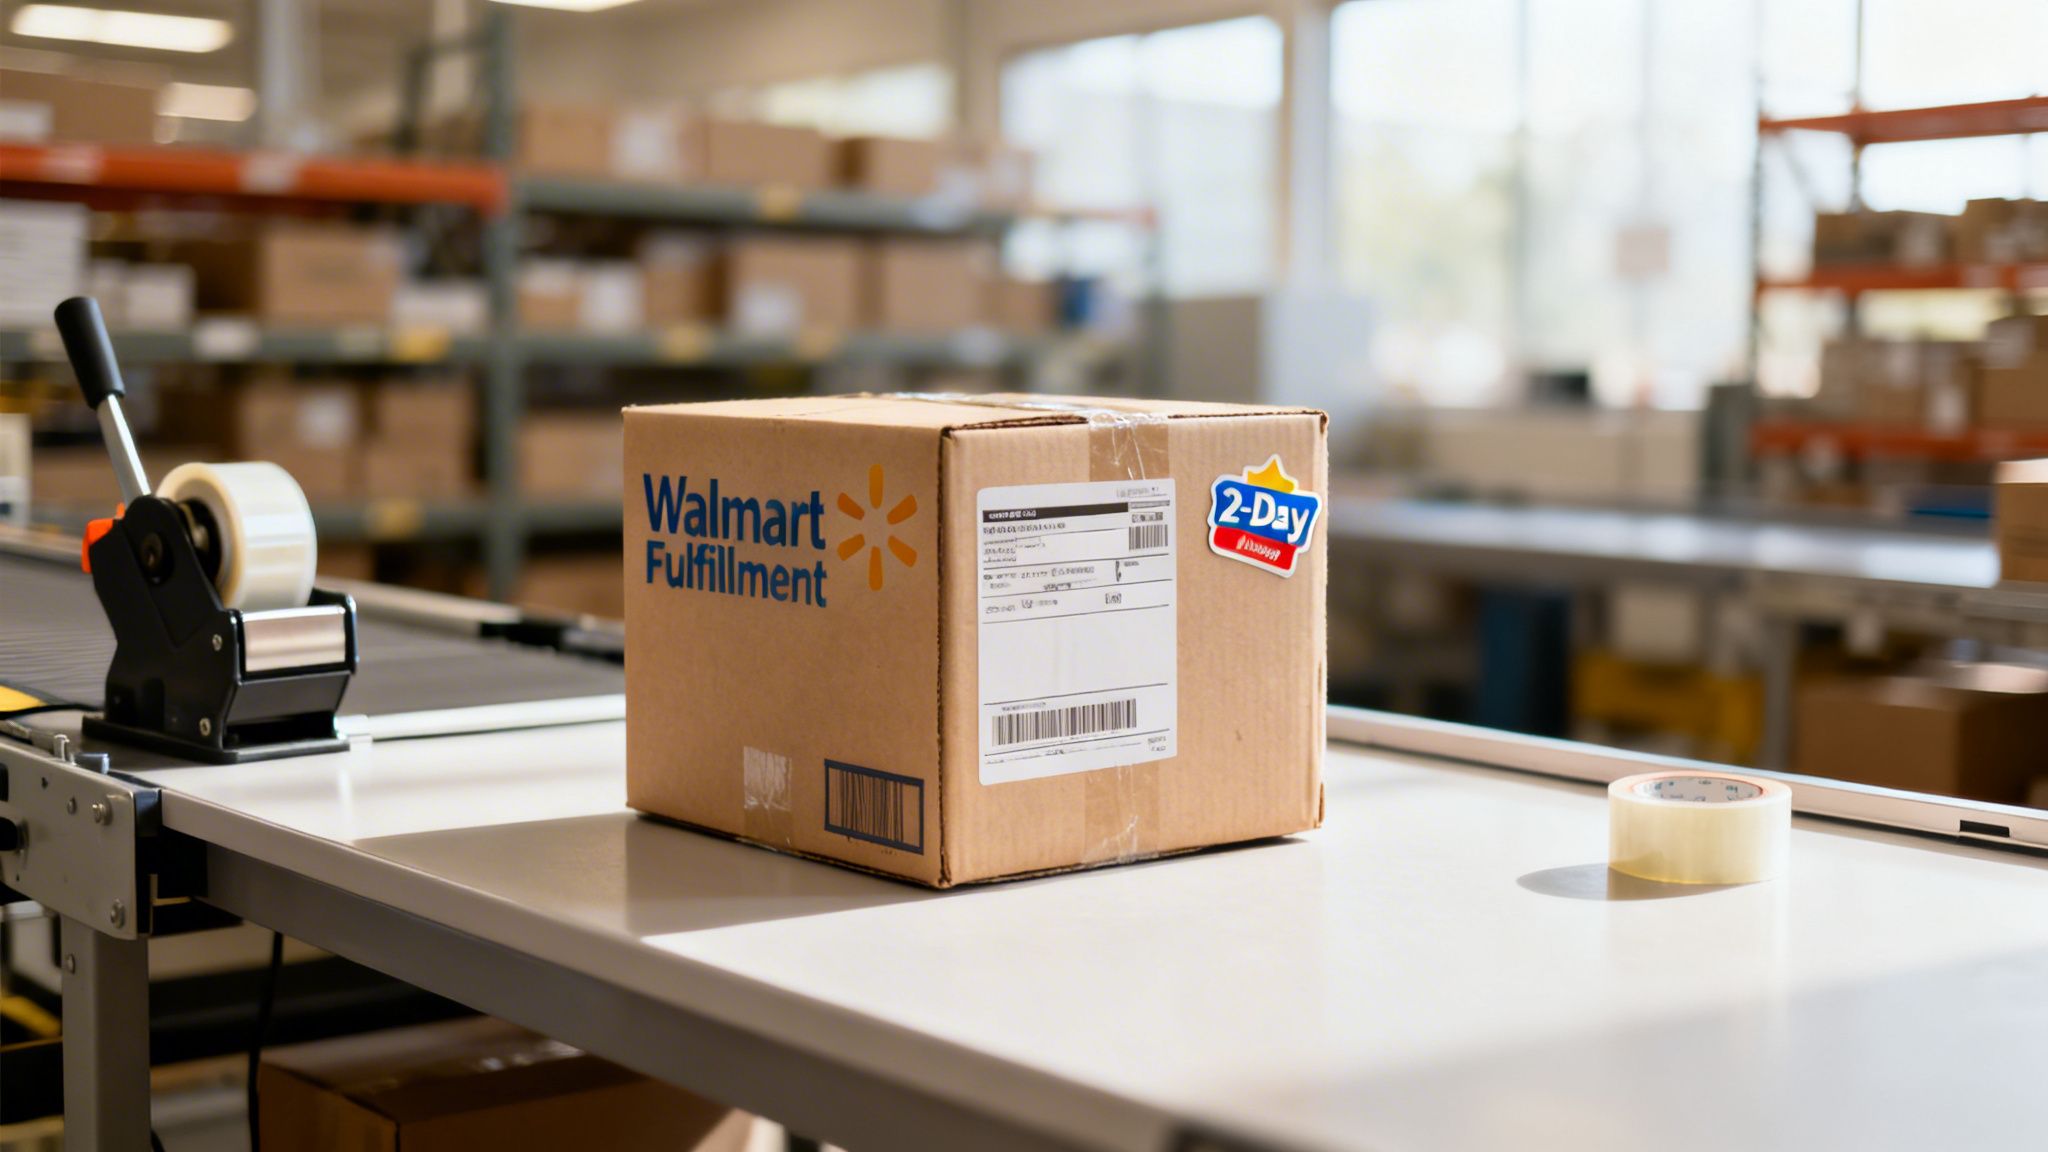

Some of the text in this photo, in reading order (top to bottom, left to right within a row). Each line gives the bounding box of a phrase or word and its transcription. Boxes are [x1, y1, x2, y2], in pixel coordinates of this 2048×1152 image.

[643, 473, 826, 550] Walmart
[1218, 487, 1310, 544] 2-Day
[646, 540, 827, 608] Fulfillment
